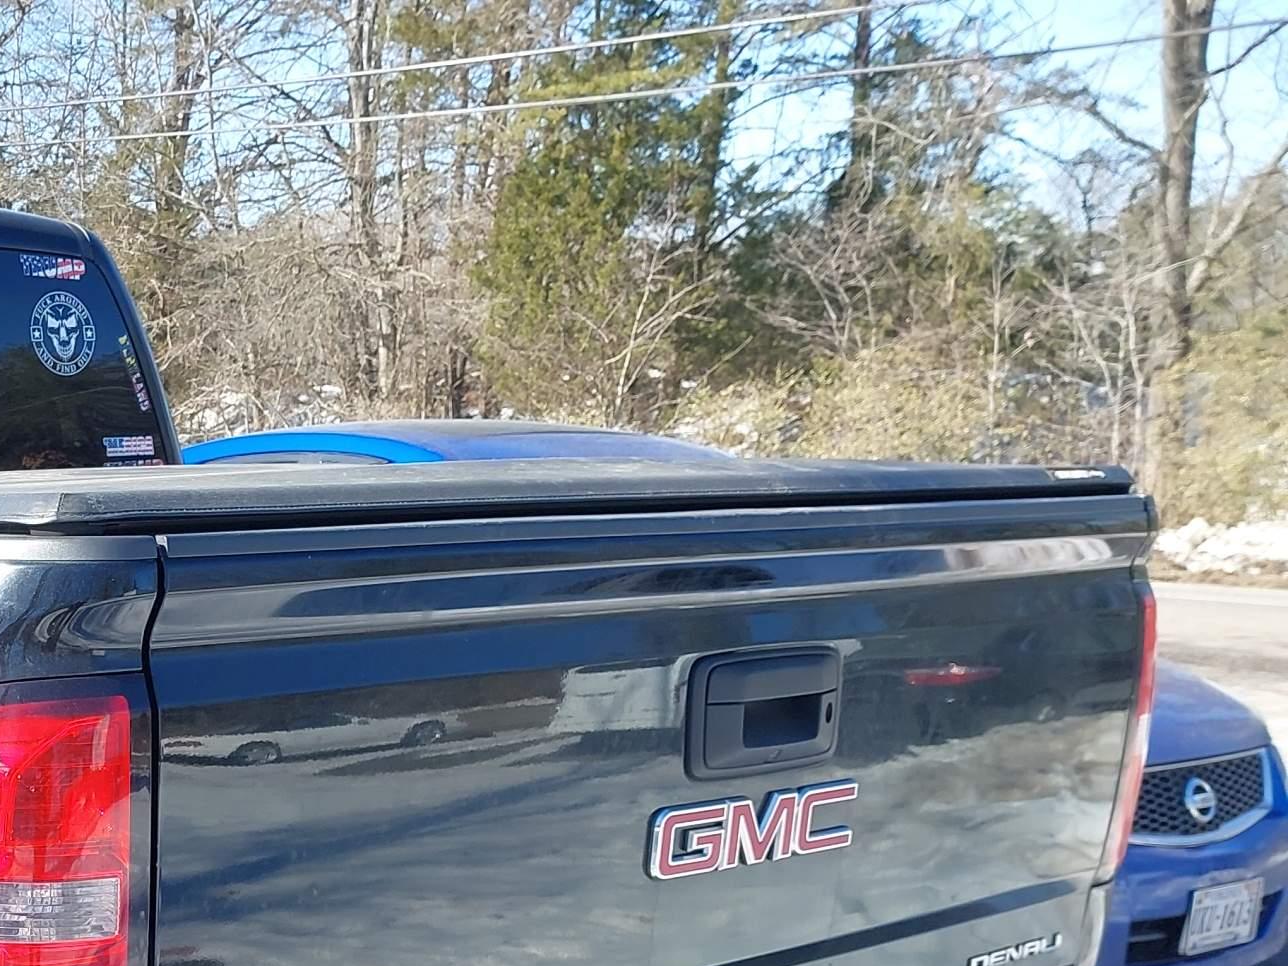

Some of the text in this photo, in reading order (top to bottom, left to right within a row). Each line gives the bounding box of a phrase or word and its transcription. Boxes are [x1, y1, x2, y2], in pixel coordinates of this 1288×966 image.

[19, 253, 87, 281] TRUMP
[34, 294, 88, 320] FUCK AROUND
[37, 347, 93, 373] AND FIND OUT
[644, 780, 859, 880] GMC
